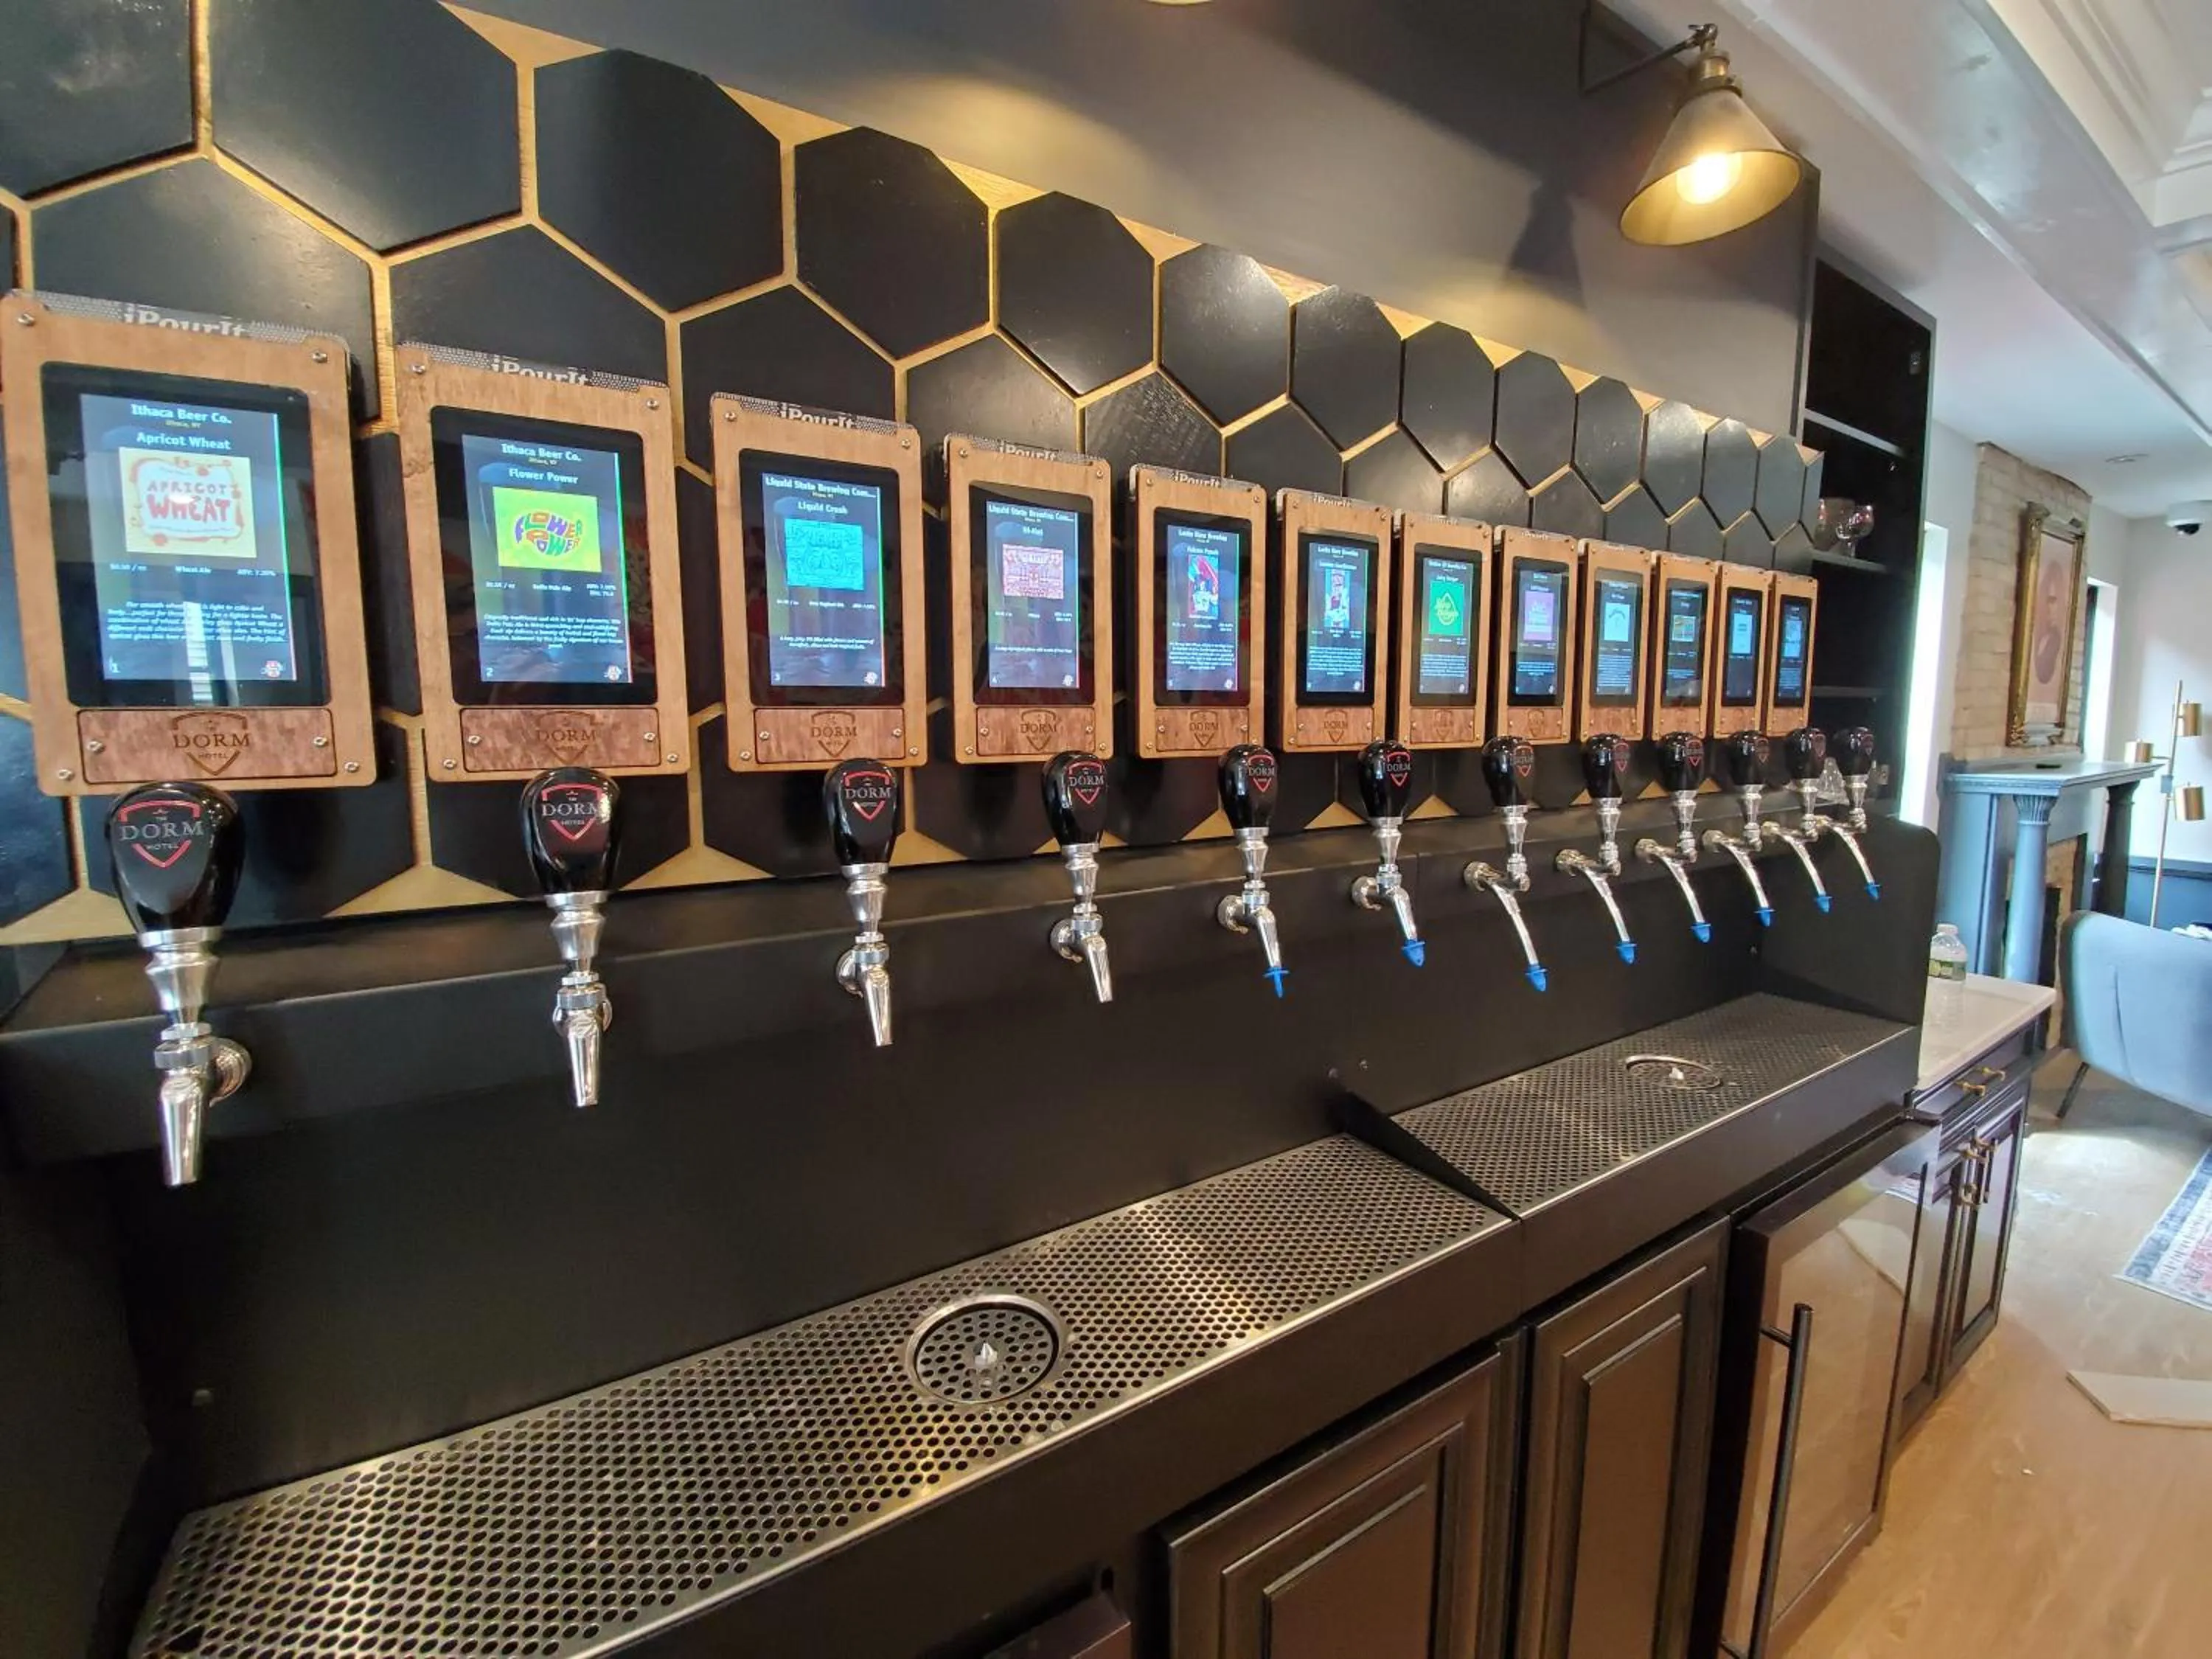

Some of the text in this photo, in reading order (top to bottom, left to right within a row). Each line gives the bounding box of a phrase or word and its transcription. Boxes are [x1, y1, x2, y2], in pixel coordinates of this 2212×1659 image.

[131, 404, 232, 424] Ithaca Beer Co.
[136, 432, 232, 451] Apricot Wheat
[501, 443, 581, 462] Ithaca Beer Co.
[509, 467, 578, 484] Flower Power
[147, 480, 227, 495] APRICOT
[765, 477, 792, 488] Liquid
[794, 480, 815, 491] State
[818, 483, 850, 496] Brewing
[147, 494, 230, 522] WHEAT
[798, 501, 824, 513] Liquid
[537, 729, 596, 741] DORM
[811, 727, 857, 738] DORM
[1020, 723, 1057, 734] DORM
[173, 733, 251, 748] DORM
[1069, 775, 1105, 787] DORM
[845, 787, 891, 799] DORM
[119, 821, 204, 841] DORM
